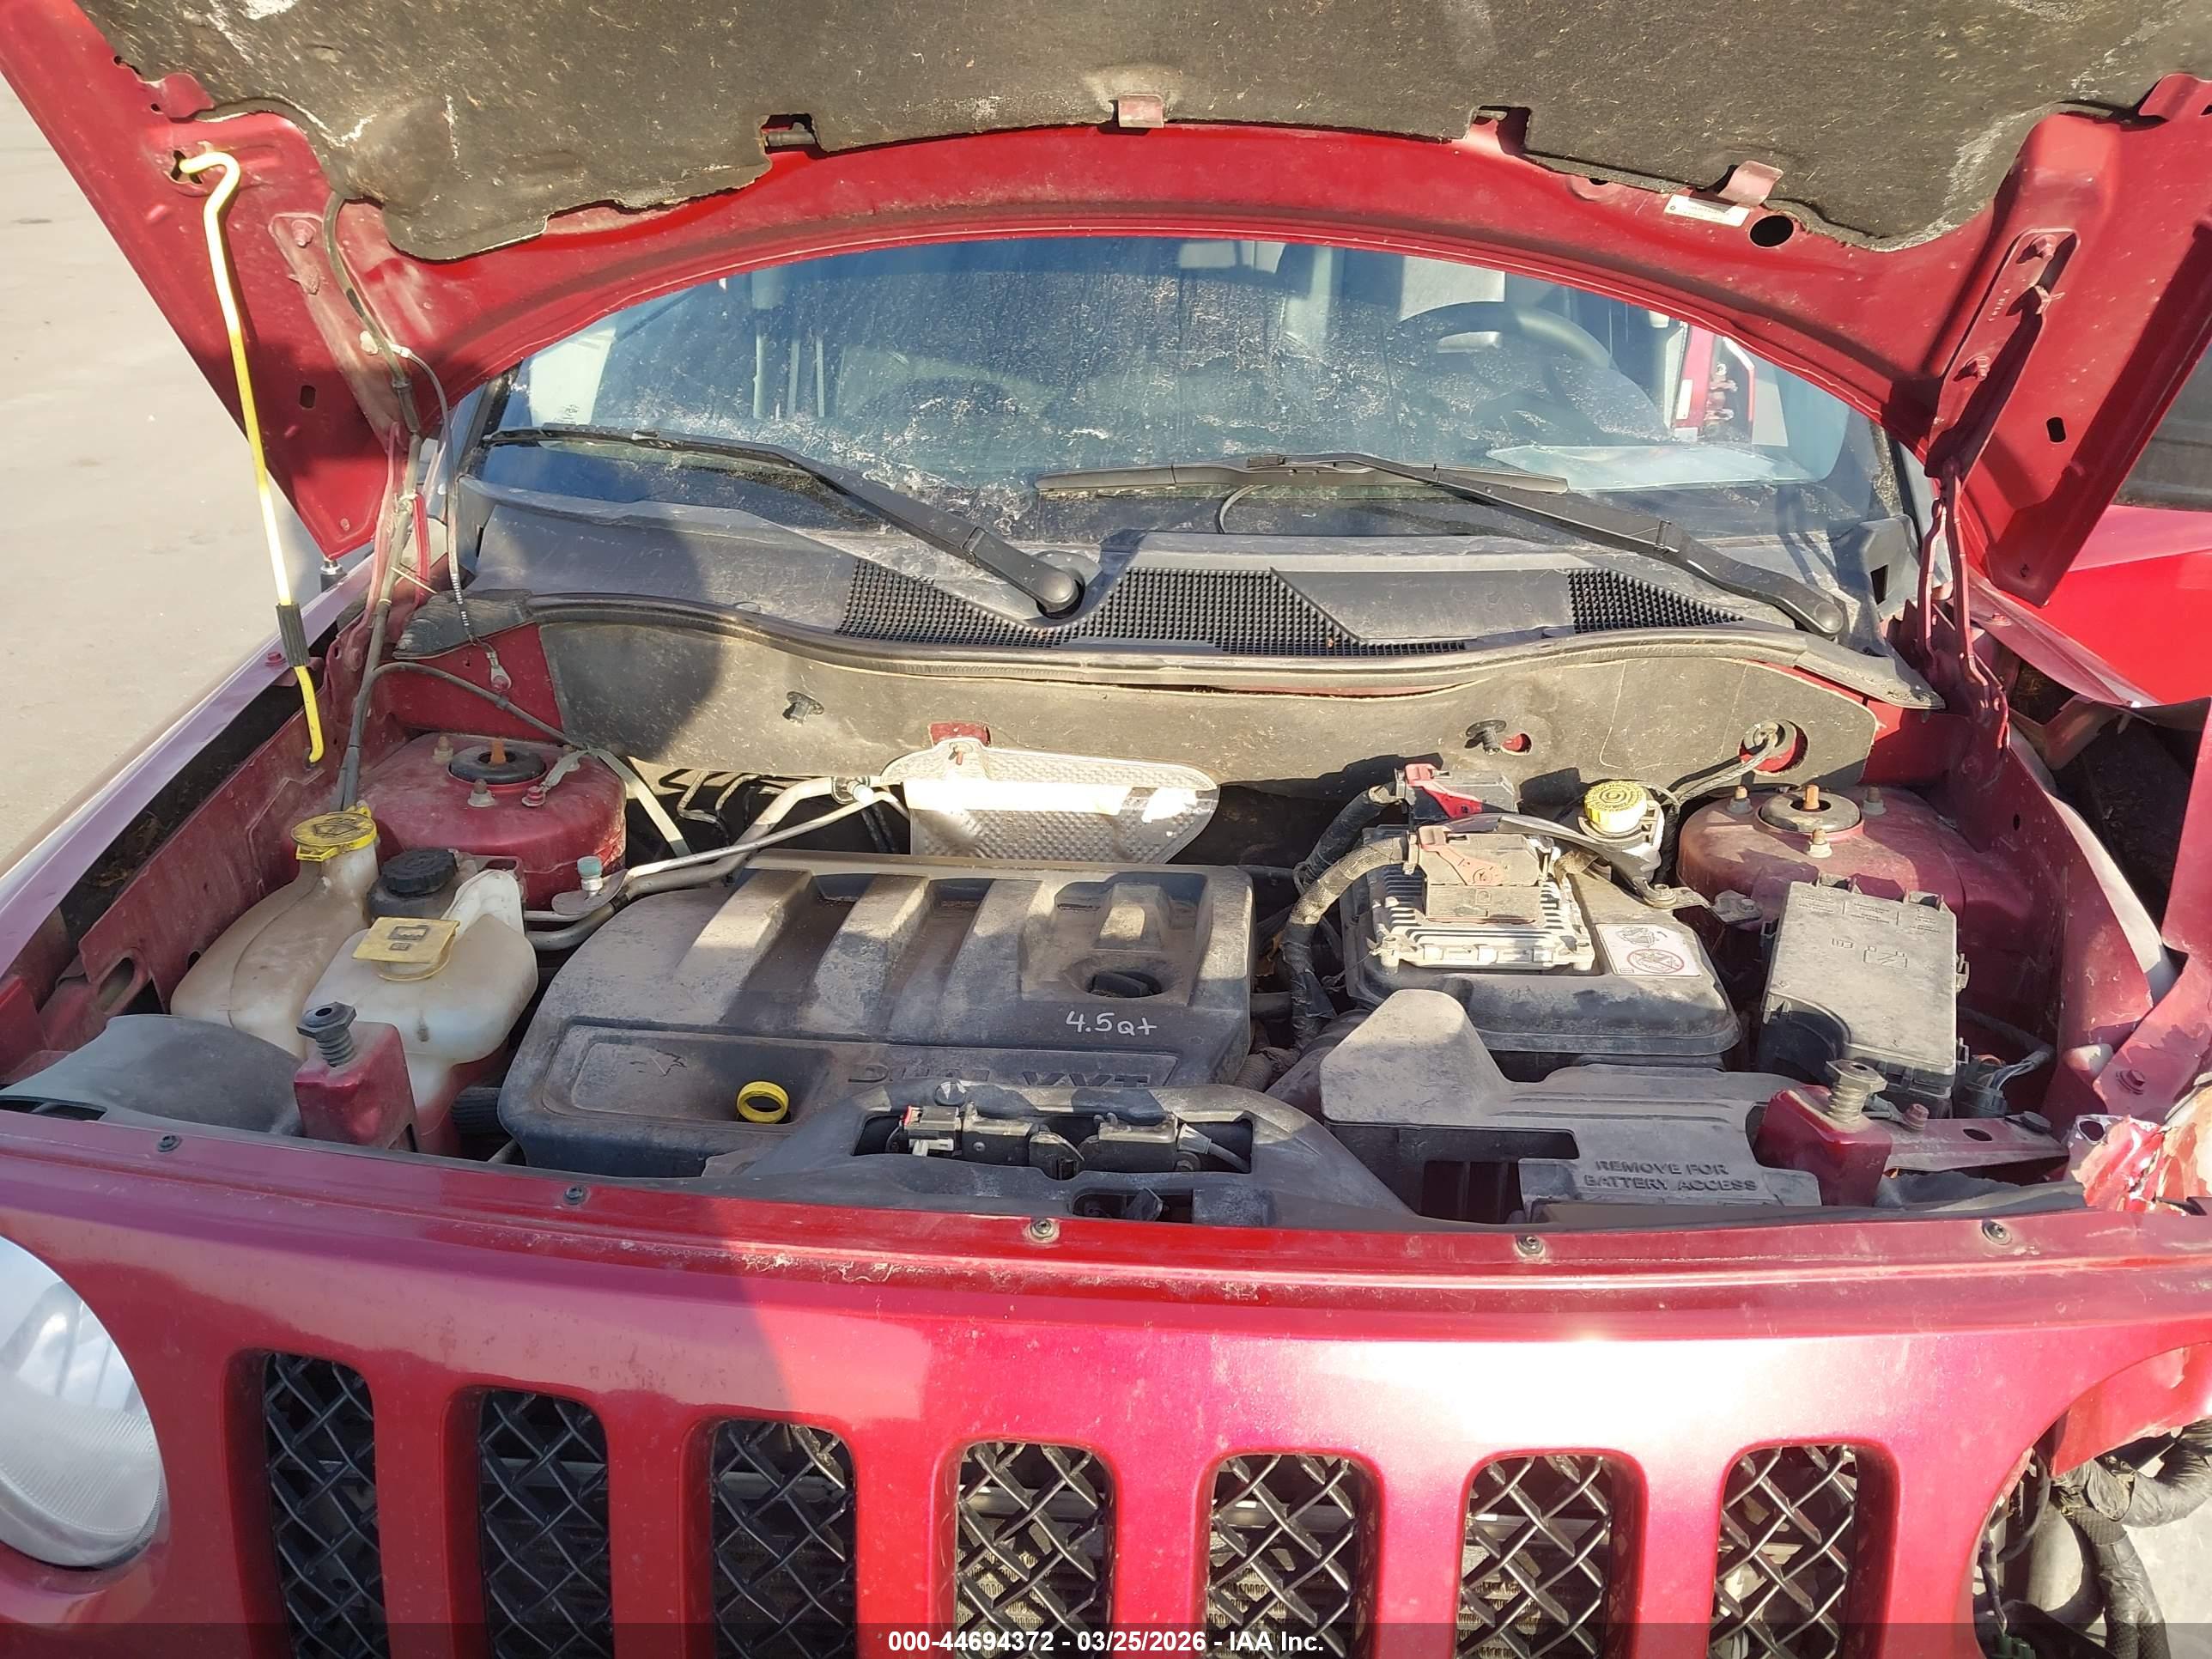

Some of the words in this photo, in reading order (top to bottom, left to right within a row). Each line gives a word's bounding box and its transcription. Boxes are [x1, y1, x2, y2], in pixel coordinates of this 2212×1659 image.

[1595, 1160, 1682, 1176] REMOVE
[1686, 1163, 1729, 1176] FOR
[1584, 1174, 1669, 1190] BATTERY
[1678, 1178, 1758, 1192] ACCESS
